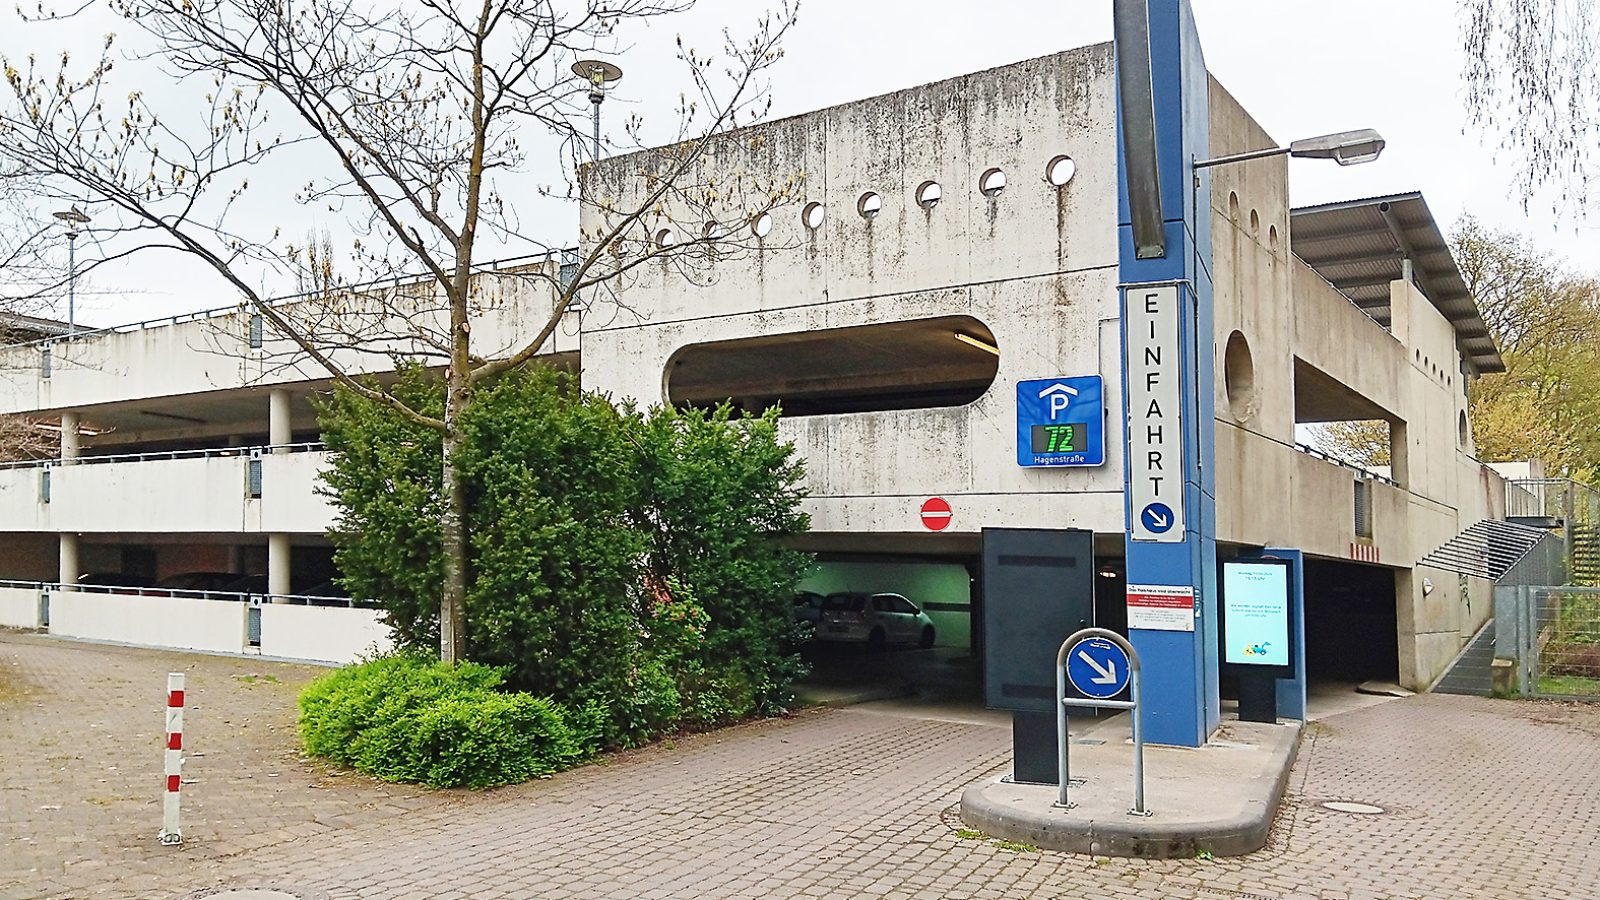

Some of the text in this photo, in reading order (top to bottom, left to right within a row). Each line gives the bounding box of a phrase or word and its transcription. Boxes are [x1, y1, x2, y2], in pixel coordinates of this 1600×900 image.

[1051, 394, 1069, 420] P
[1145, 293, 1164, 496] EINFAHRT
[1044, 426, 1074, 452] 72
[1034, 454, 1085, 465] Hagenstraße
